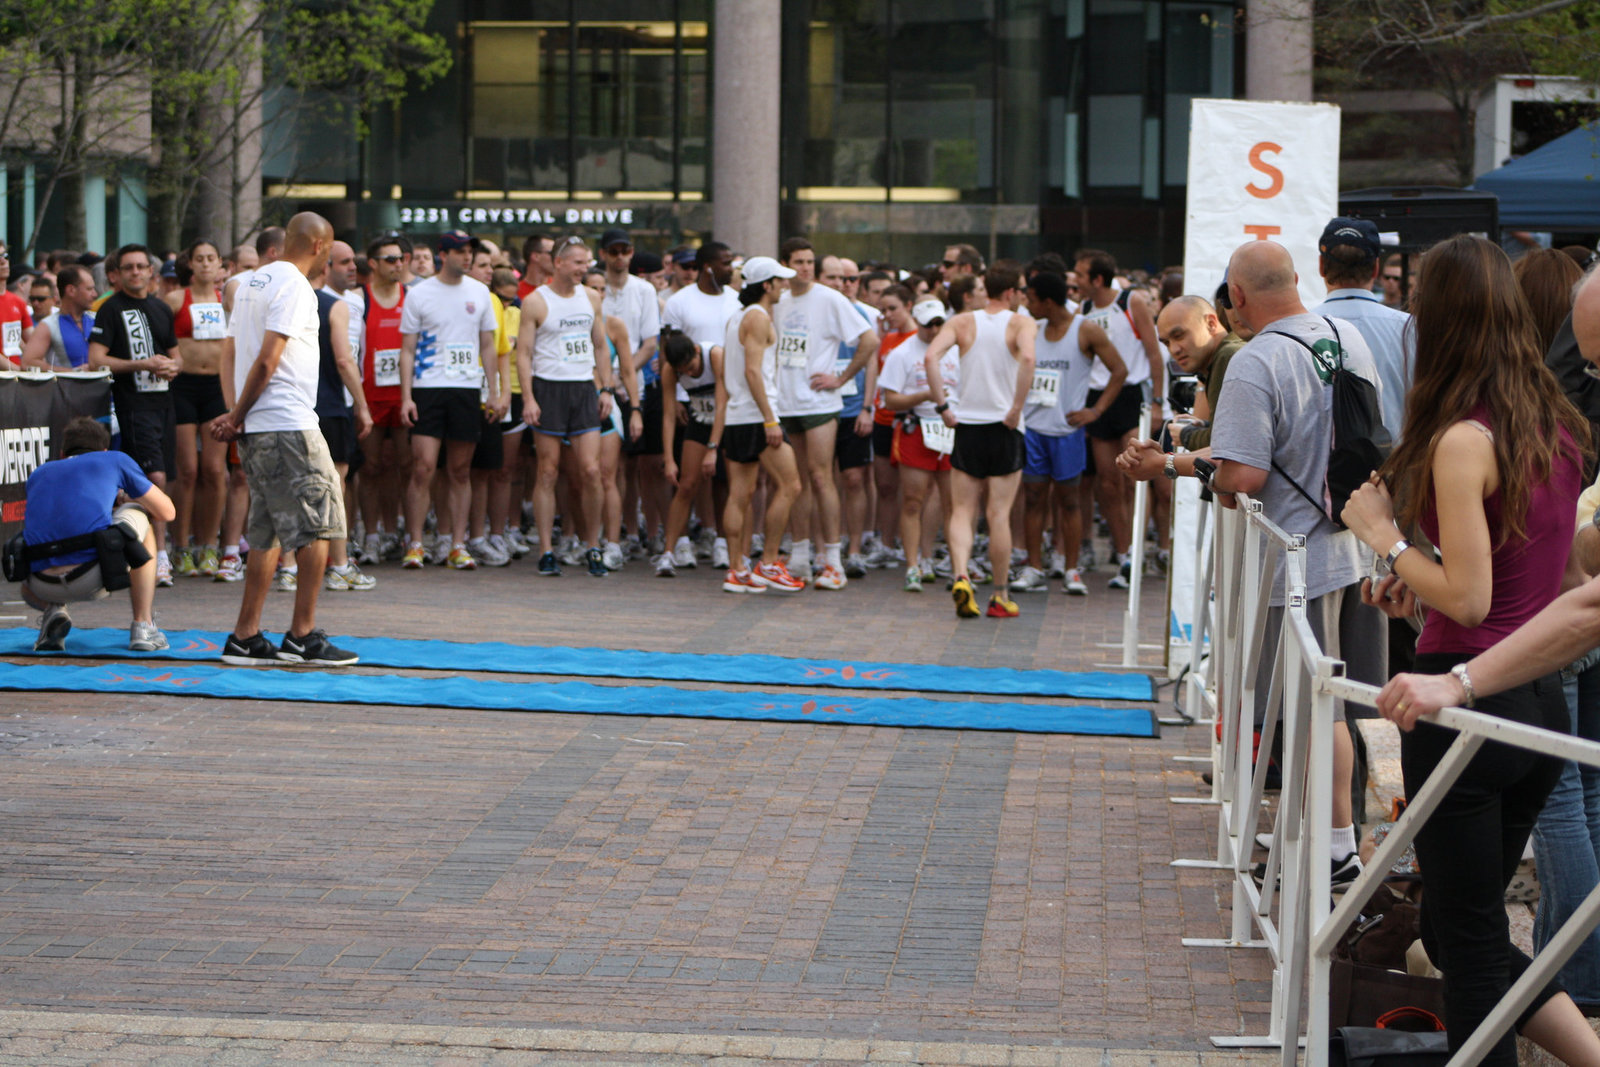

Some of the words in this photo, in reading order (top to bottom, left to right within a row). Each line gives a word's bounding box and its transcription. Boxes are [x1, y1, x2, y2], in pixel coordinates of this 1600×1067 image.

[400, 207, 449, 223] 2231
[458, 207, 556, 223] CRYSTAL
[564, 207, 634, 223] DRIVE
[565, 339, 588, 355] 966
[780, 336, 807, 353] 1254
[381, 356, 401, 372] 23
[450, 350, 472, 365] 389
